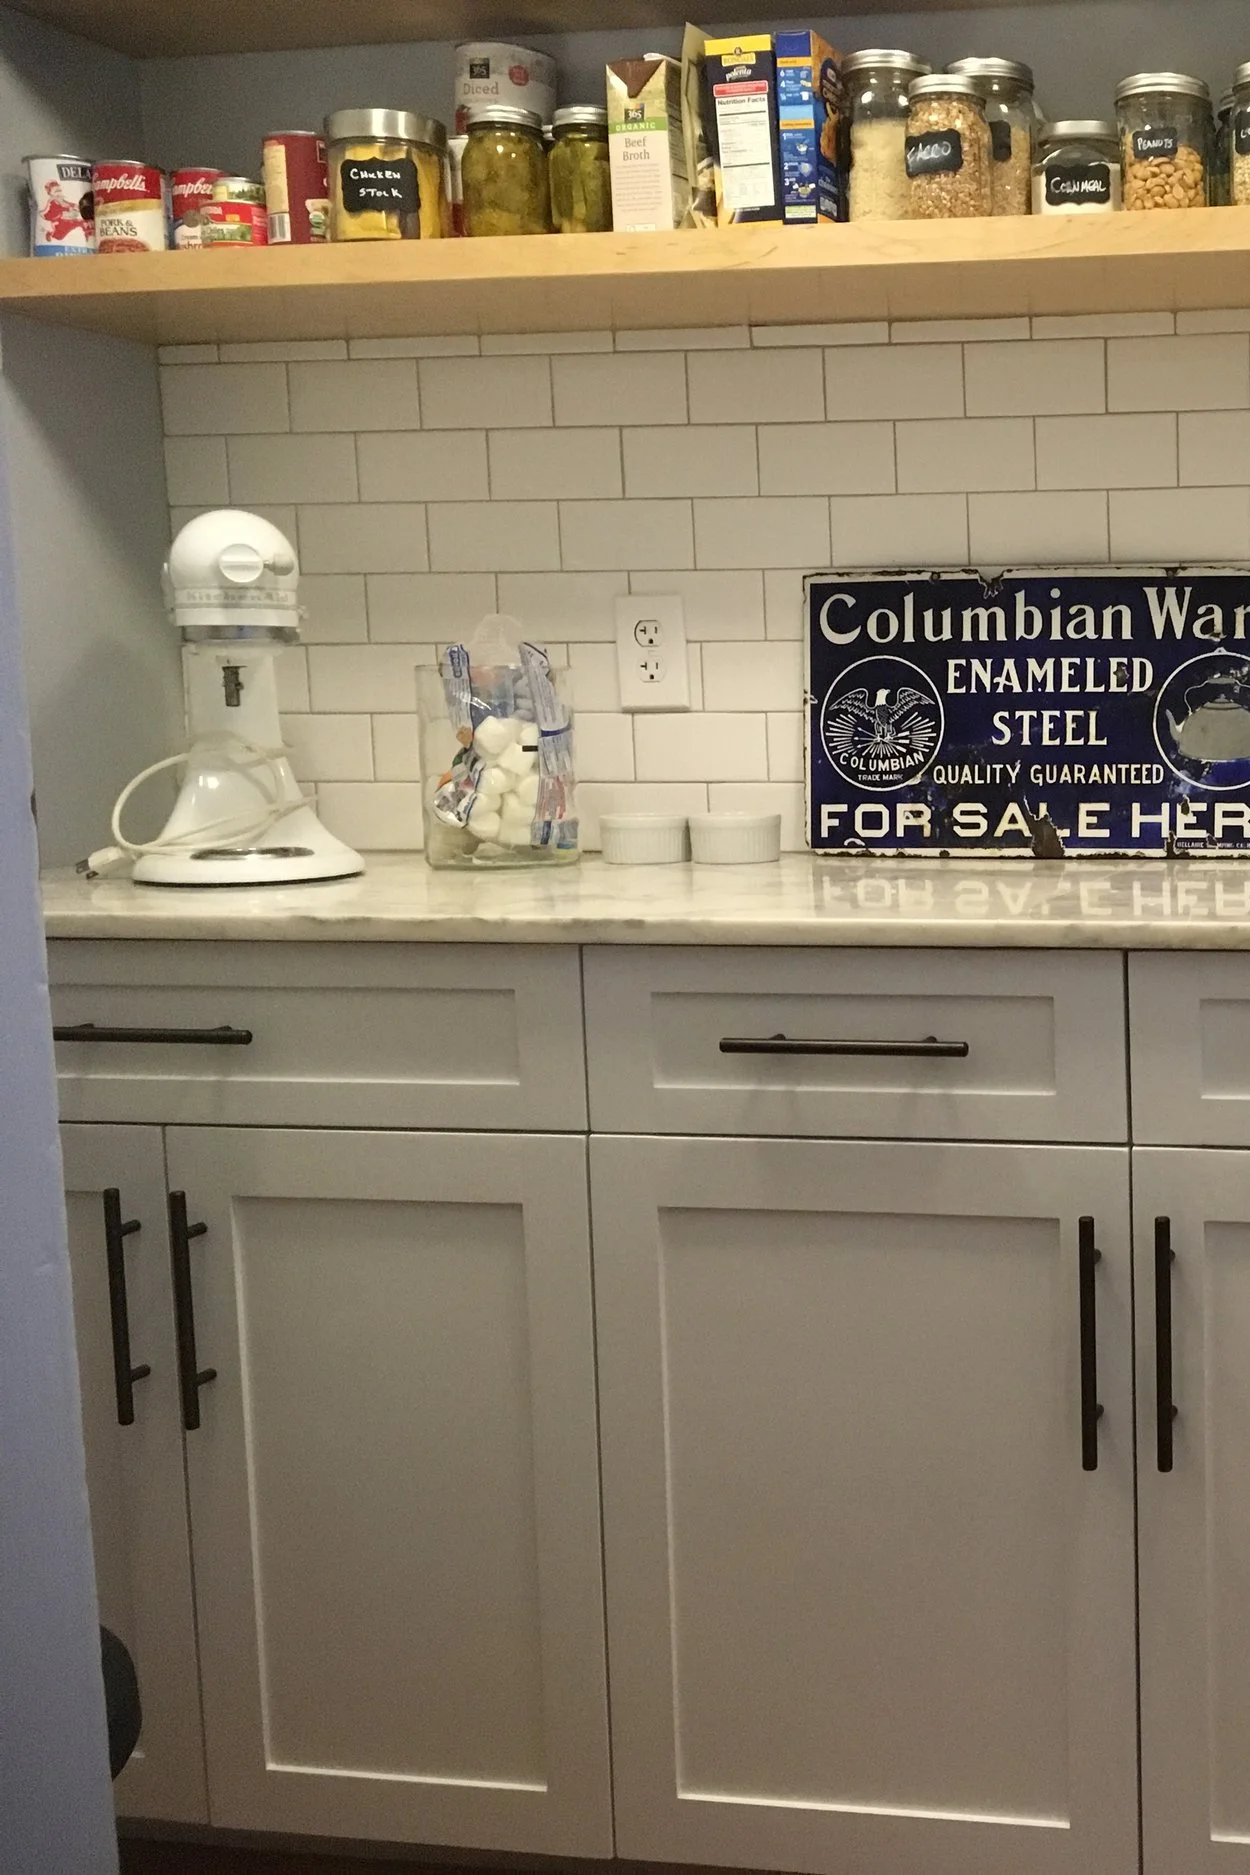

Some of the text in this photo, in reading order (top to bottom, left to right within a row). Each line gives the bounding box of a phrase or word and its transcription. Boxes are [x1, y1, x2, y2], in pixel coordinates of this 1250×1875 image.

[463, 83, 499, 95] Diced
[627, 110, 642, 121] 365
[616, 122, 656, 132] ORGANIC
[624, 136, 647, 149] Beef
[1137, 137, 1174, 151] PEANUTS
[622, 150, 650, 162] Broth
[100, 219, 123, 228] PORK
[100, 226, 138, 238] BEANS
[819, 588, 1133, 645] Columbian
[947, 656, 1154, 694] ENAMELED
[991, 710, 1108, 746] STEEL
[839, 751, 925, 772] COLUMBIAN
[857, 774, 904, 782] TRADE MARK
[933, 764, 1165, 786] QUALITY GUARANTEED
[820, 803, 932, 838] FOR
